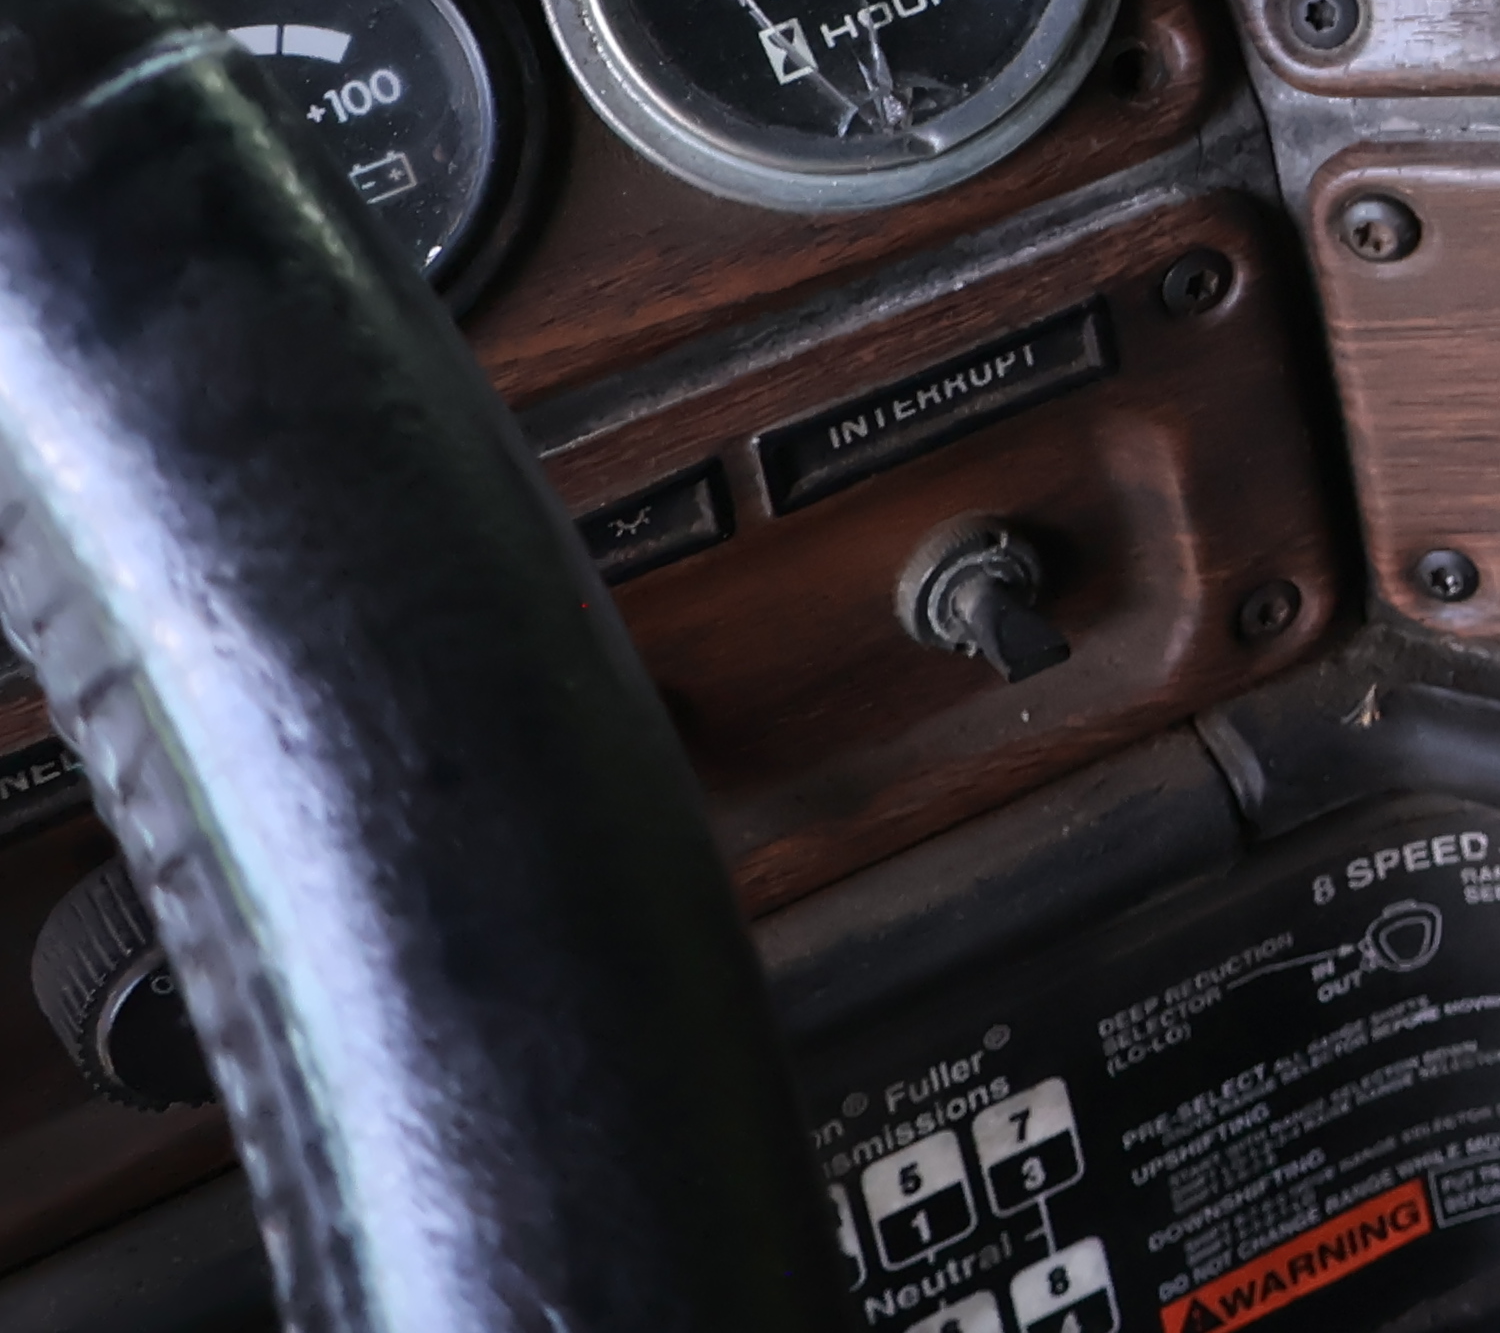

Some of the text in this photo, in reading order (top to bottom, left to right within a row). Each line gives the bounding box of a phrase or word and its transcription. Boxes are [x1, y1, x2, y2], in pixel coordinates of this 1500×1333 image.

[305, 68, 403, 129] +100
[1312, 873, 1337, 906] 8
[1346, 832, 1490, 892] SPEED
[1316, 969, 1363, 1004] OUT
[1008, 1109, 1033, 1142] 7
[899, 1163, 921, 1195] 5
[1020, 1158, 1047, 1191] 3
[910, 1208, 931, 1243] 1
[1219, 1200, 1421, 1321] WARNING
[863, 1230, 1014, 1327] Neutral
[1047, 1266, 1070, 1296] 8
